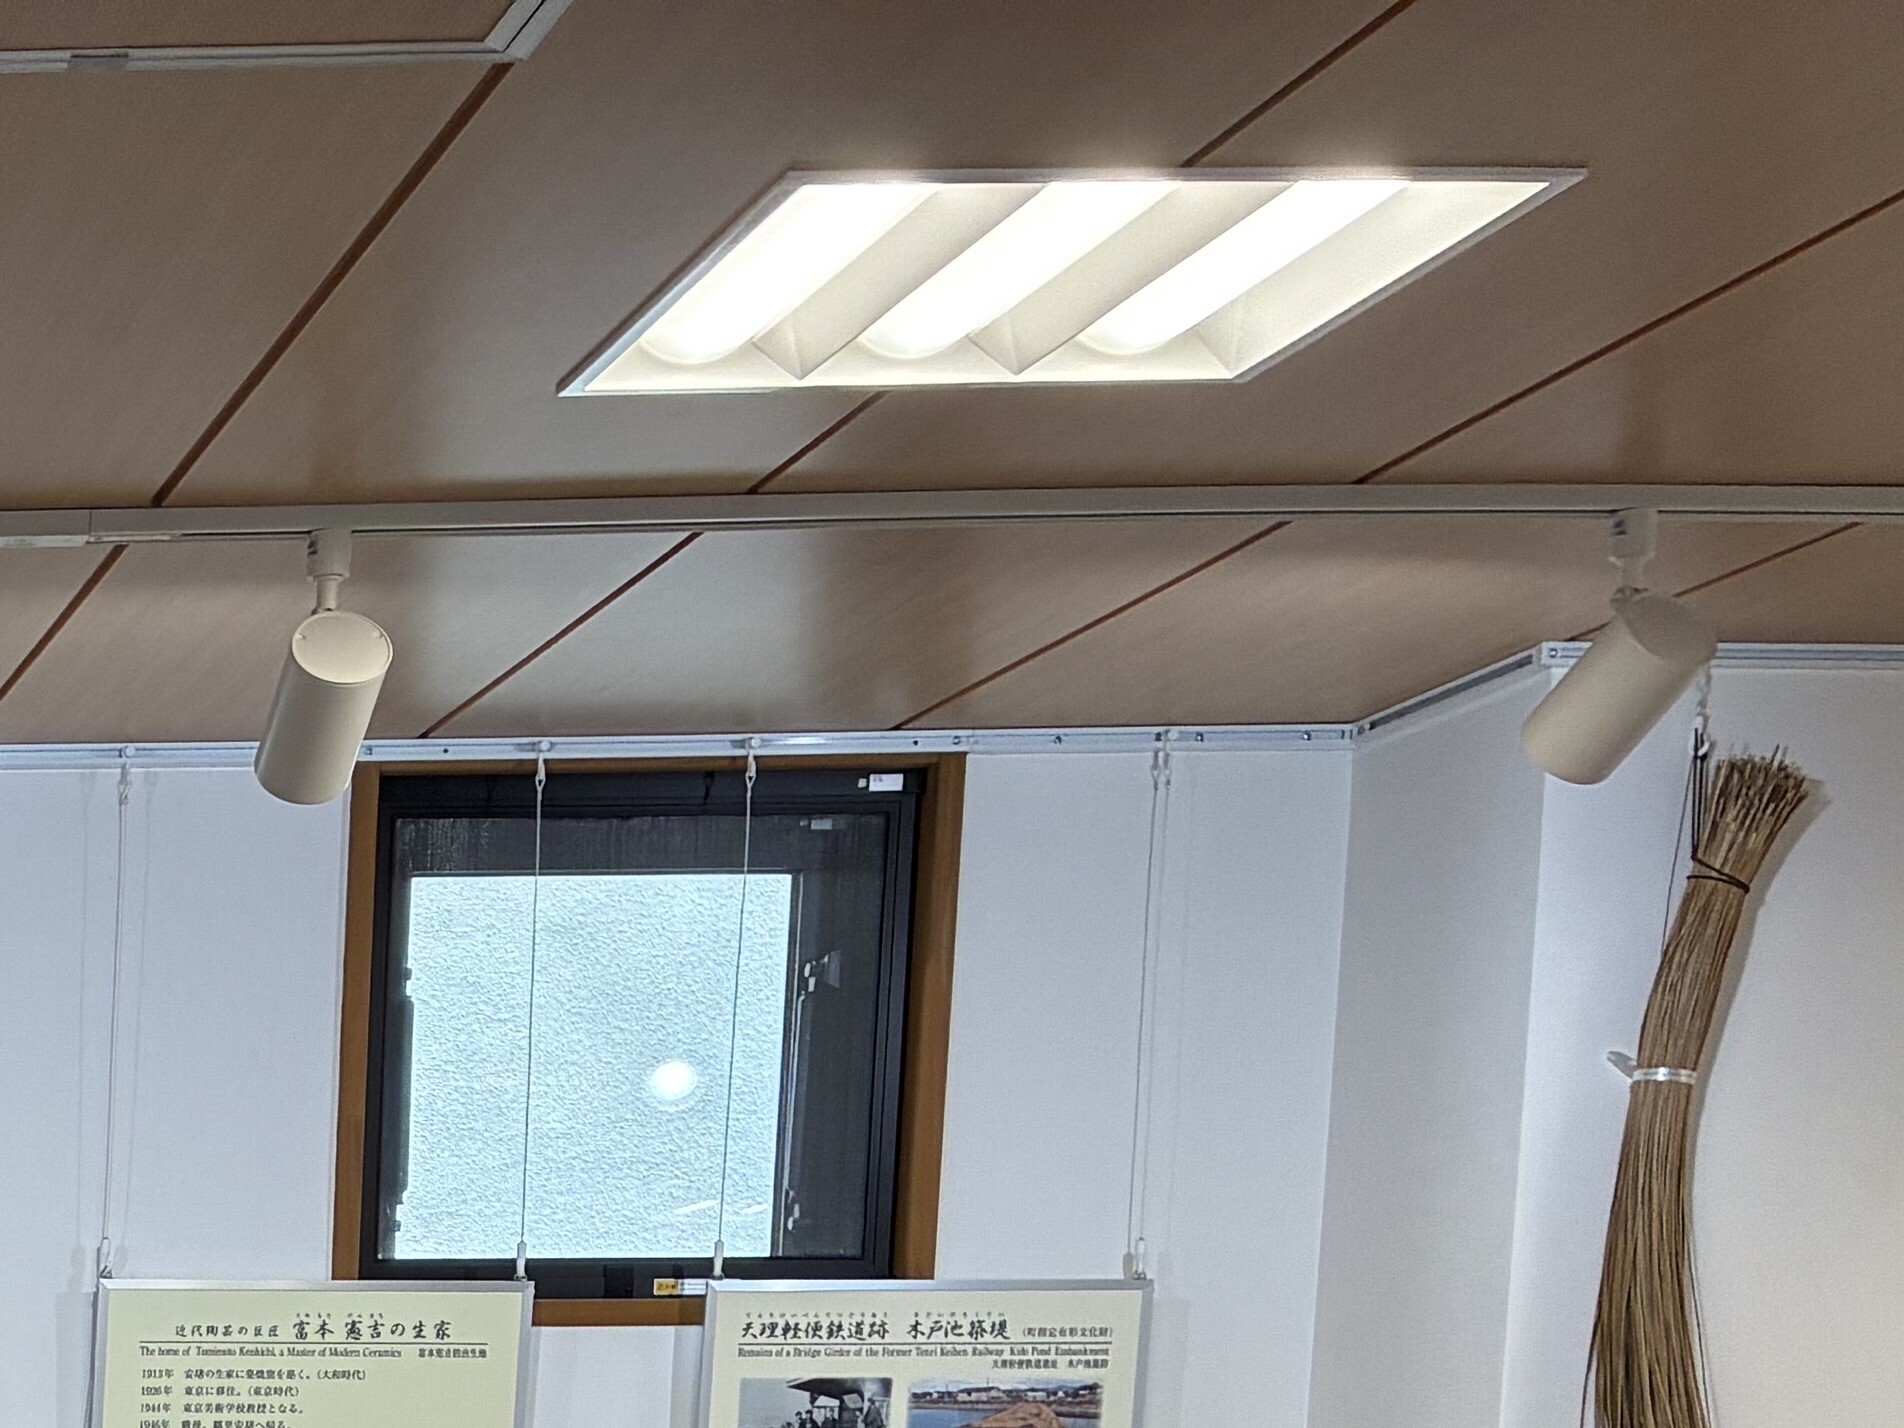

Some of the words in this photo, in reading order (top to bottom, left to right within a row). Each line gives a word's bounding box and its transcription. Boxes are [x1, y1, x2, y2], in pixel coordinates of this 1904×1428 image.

[293, 1320, 334, 1340] 富本
[345, 1320, 452, 1340] 憲吉の生家
[742, 1321, 890, 1341] 天理軽便鉄道跡
[907, 1320, 1010, 1341] 木戸池築堤
[140, 1346, 156, 1358] The
[158, 1346, 180, 1358] home
[182, 1346, 190, 1358] of
[287, 1346, 316, 1358] Master
[318, 1346, 326, 1358] of
[329, 1346, 360, 1358] Modern
[362, 1346, 401, 1358] Ceramics
[738, 1347, 773, 1358] Remains
[776, 1347, 782, 1358] of
[793, 1347, 821, 1358] Bridge
[824, 1347, 852, 1358] Girder
[854, 1347, 862, 1358] of
[865, 1347, 879, 1358] the
[882, 1347, 912, 1358] Former
[916, 1347, 937, 1358] Tenri
[972, 1347, 1005, 1358] Railway
[1032, 1347, 1051, 1358] Pond
[1055, 1347, 1109, 1358] Embankment
